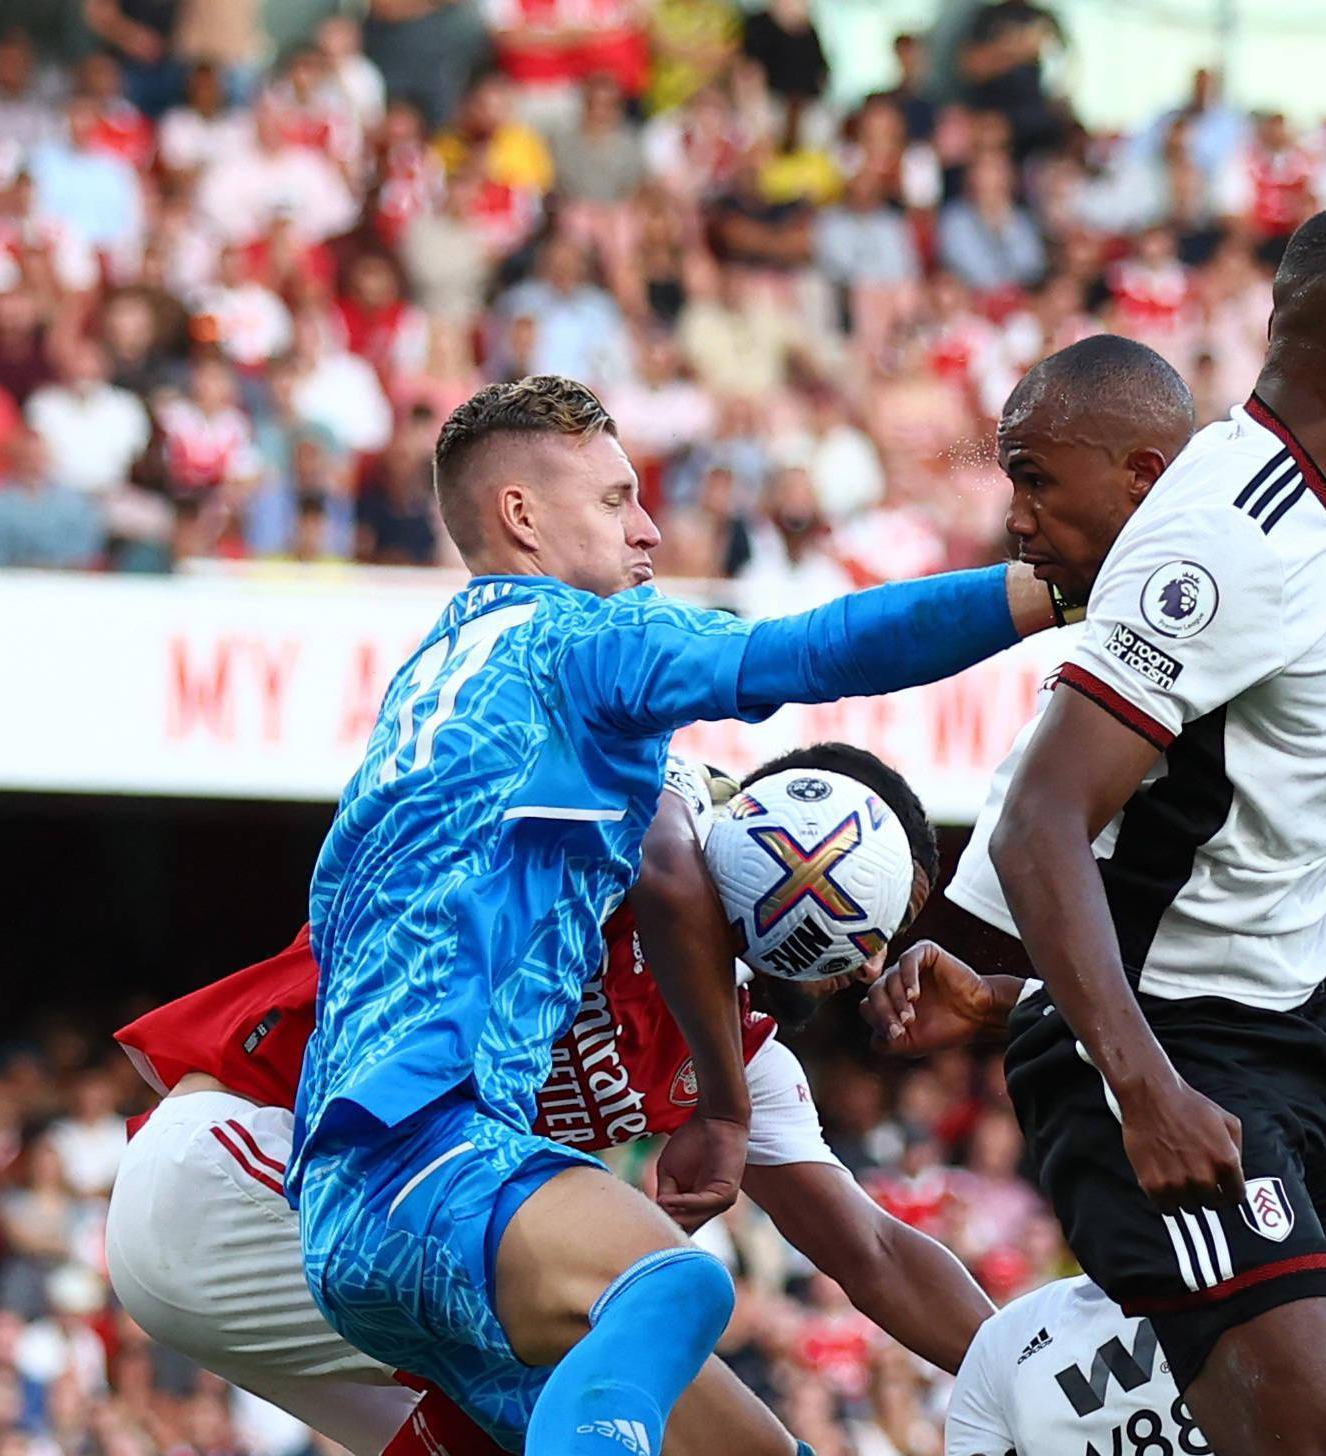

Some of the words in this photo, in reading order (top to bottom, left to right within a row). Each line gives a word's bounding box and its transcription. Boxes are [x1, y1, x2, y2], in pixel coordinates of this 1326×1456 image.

[1113, 623, 1134, 648] No
[1132, 638, 1176, 672] room
[1124, 649, 1174, 690] racism
[760, 913, 834, 977] NIKE
[573, 950, 655, 1147] mirates
